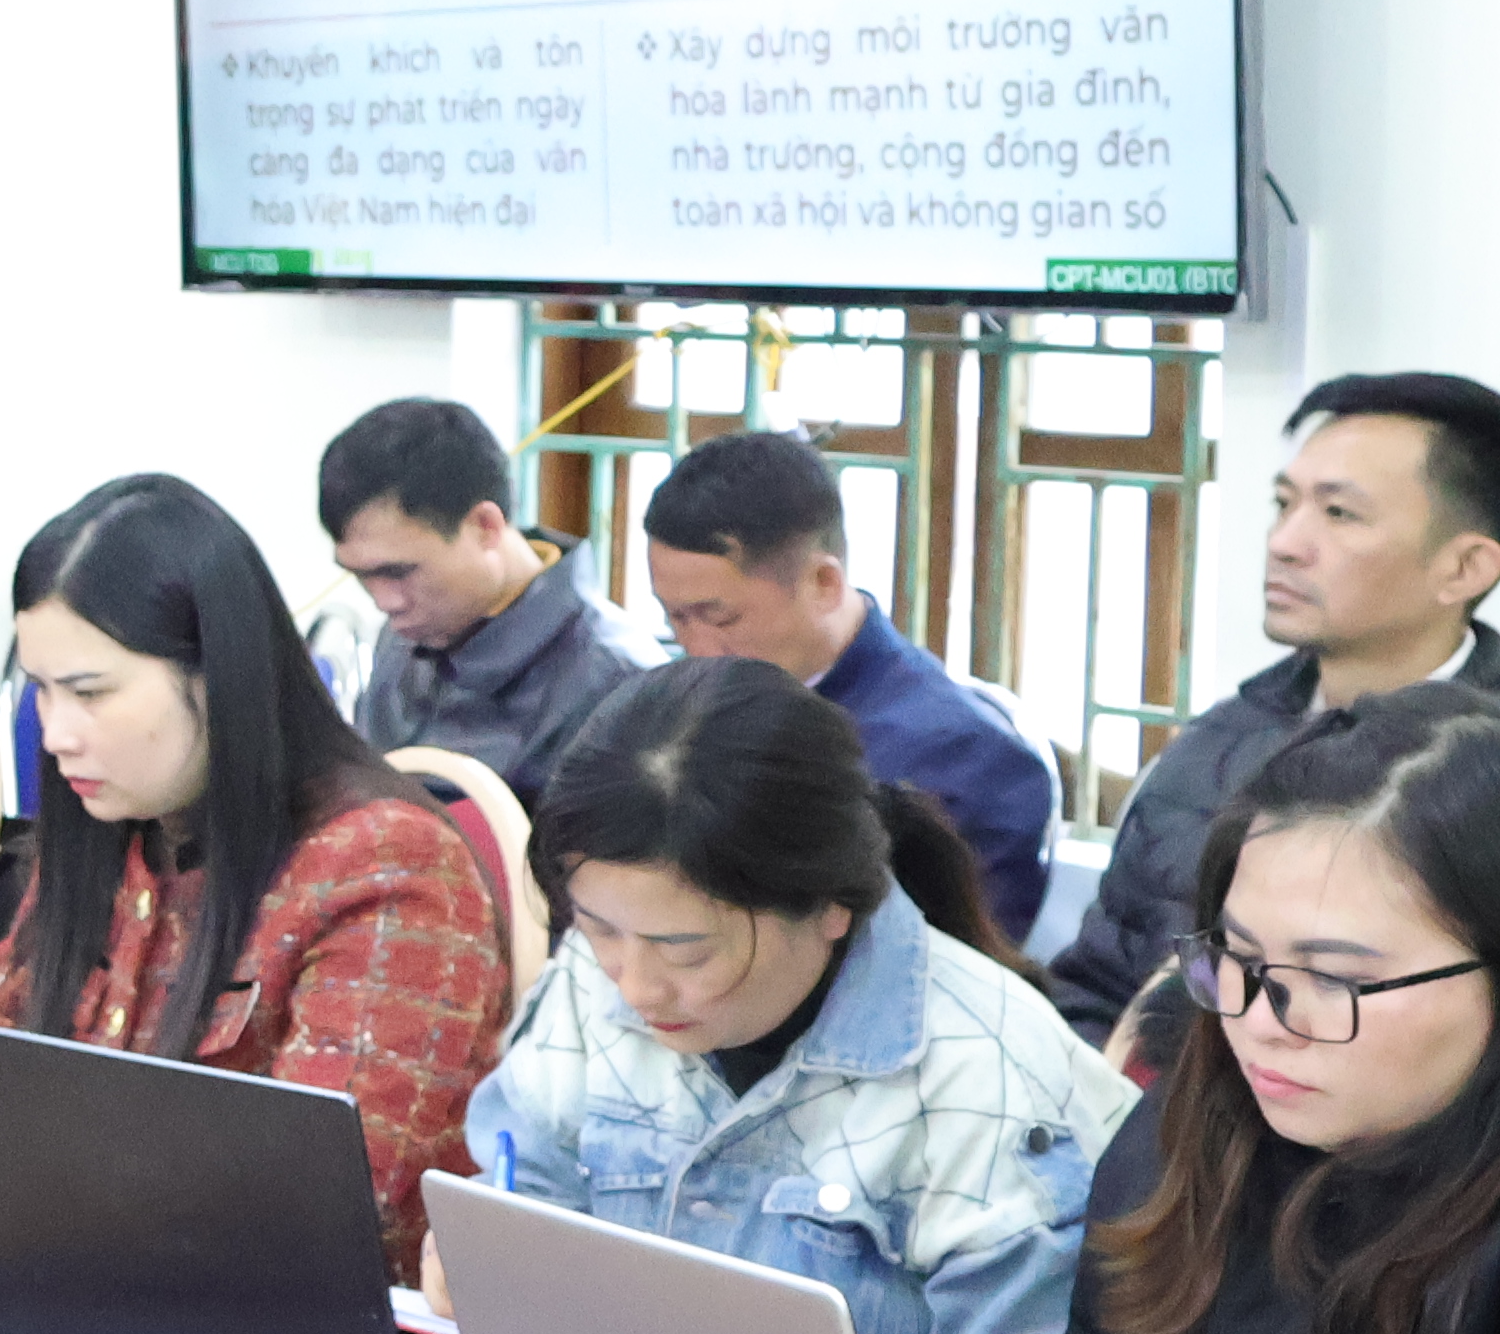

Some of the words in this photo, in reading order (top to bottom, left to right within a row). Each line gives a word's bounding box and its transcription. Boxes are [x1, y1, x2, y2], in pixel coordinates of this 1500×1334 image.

[858, 13, 921, 55] môi
[947, 11, 1072, 55] trường
[1100, 4, 1169, 44] văn
[830, 76, 928, 121] mạnh
[1001, 70, 1056, 117] gia
[880, 132, 966, 179] cộng
[358, 197, 419, 226] Nam
[672, 191, 744, 227] toàn
[797, 189, 848, 235] hội
[858, 191, 896, 227] và
[908, 190, 1020, 237] không
[1030, 189, 1112, 239] gian
[1124, 185, 1168, 229] số
